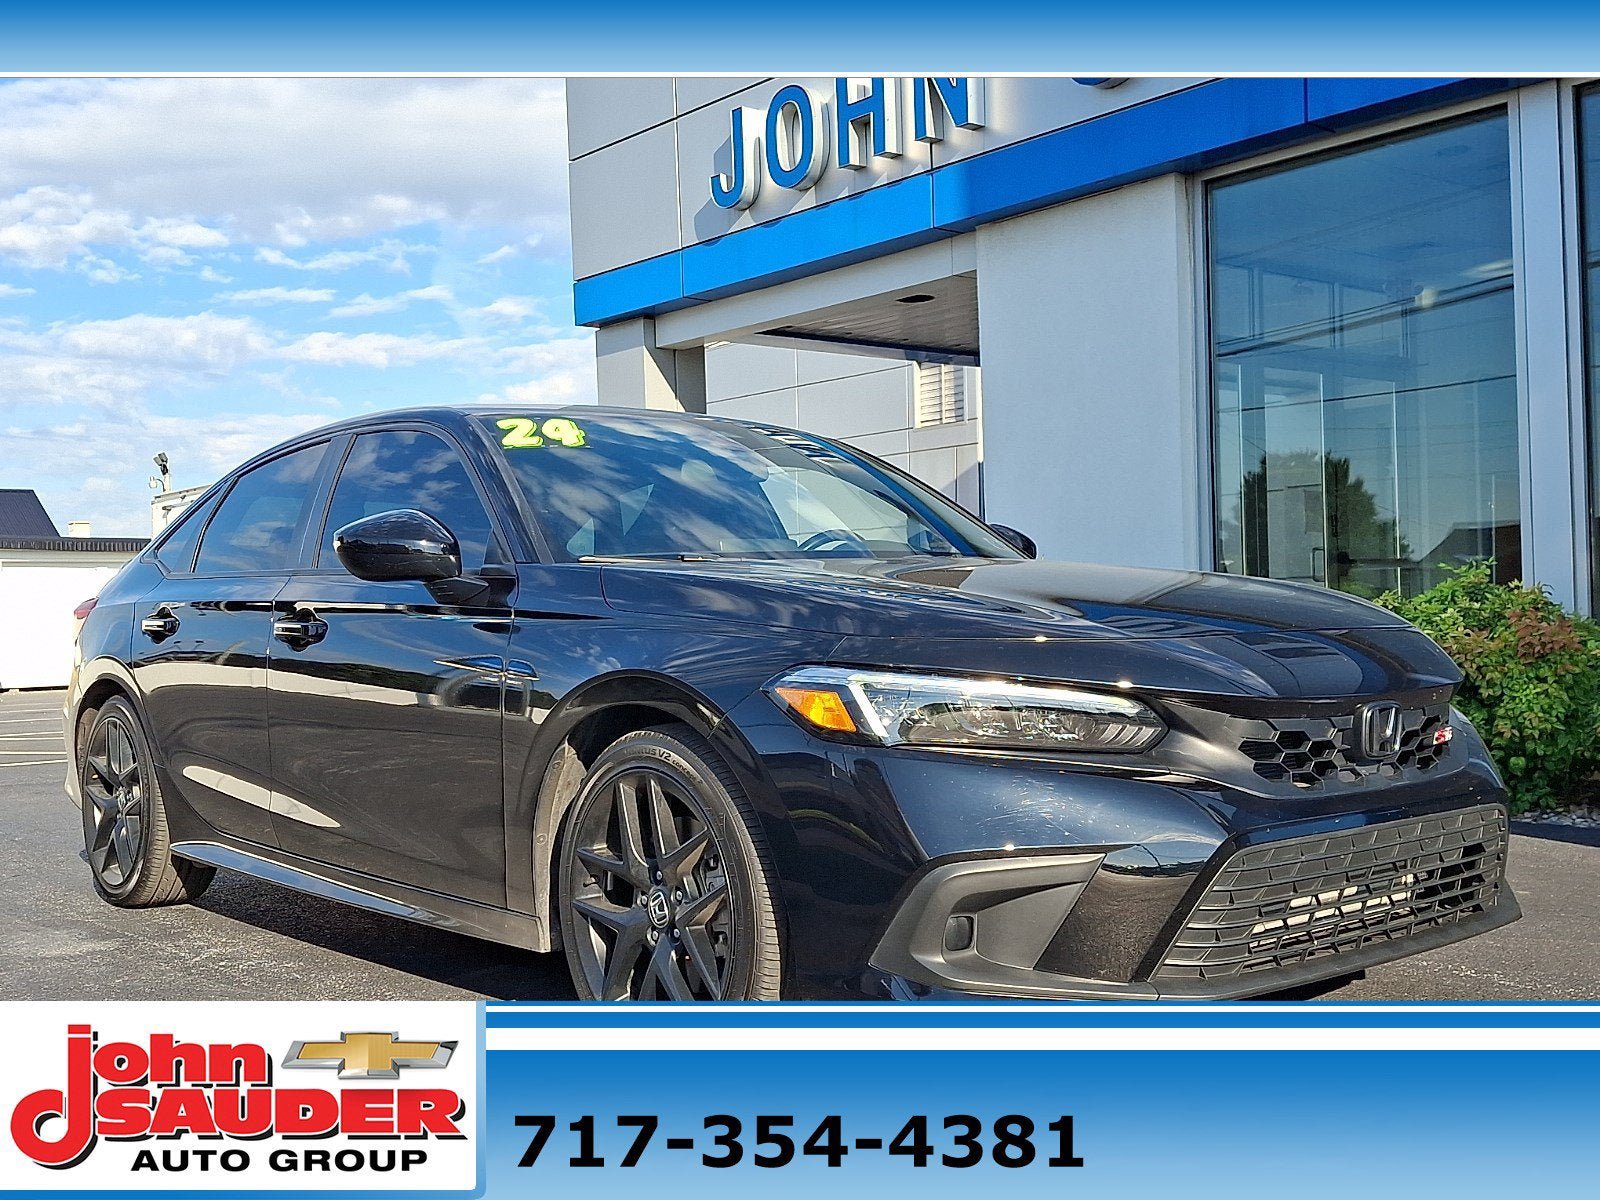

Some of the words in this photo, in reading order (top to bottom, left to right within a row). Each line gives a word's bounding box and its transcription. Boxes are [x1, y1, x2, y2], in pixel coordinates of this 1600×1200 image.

[710, 77, 983, 209] JOHN
[496, 418, 586, 447] 24
[658, 748, 672, 762] V2
